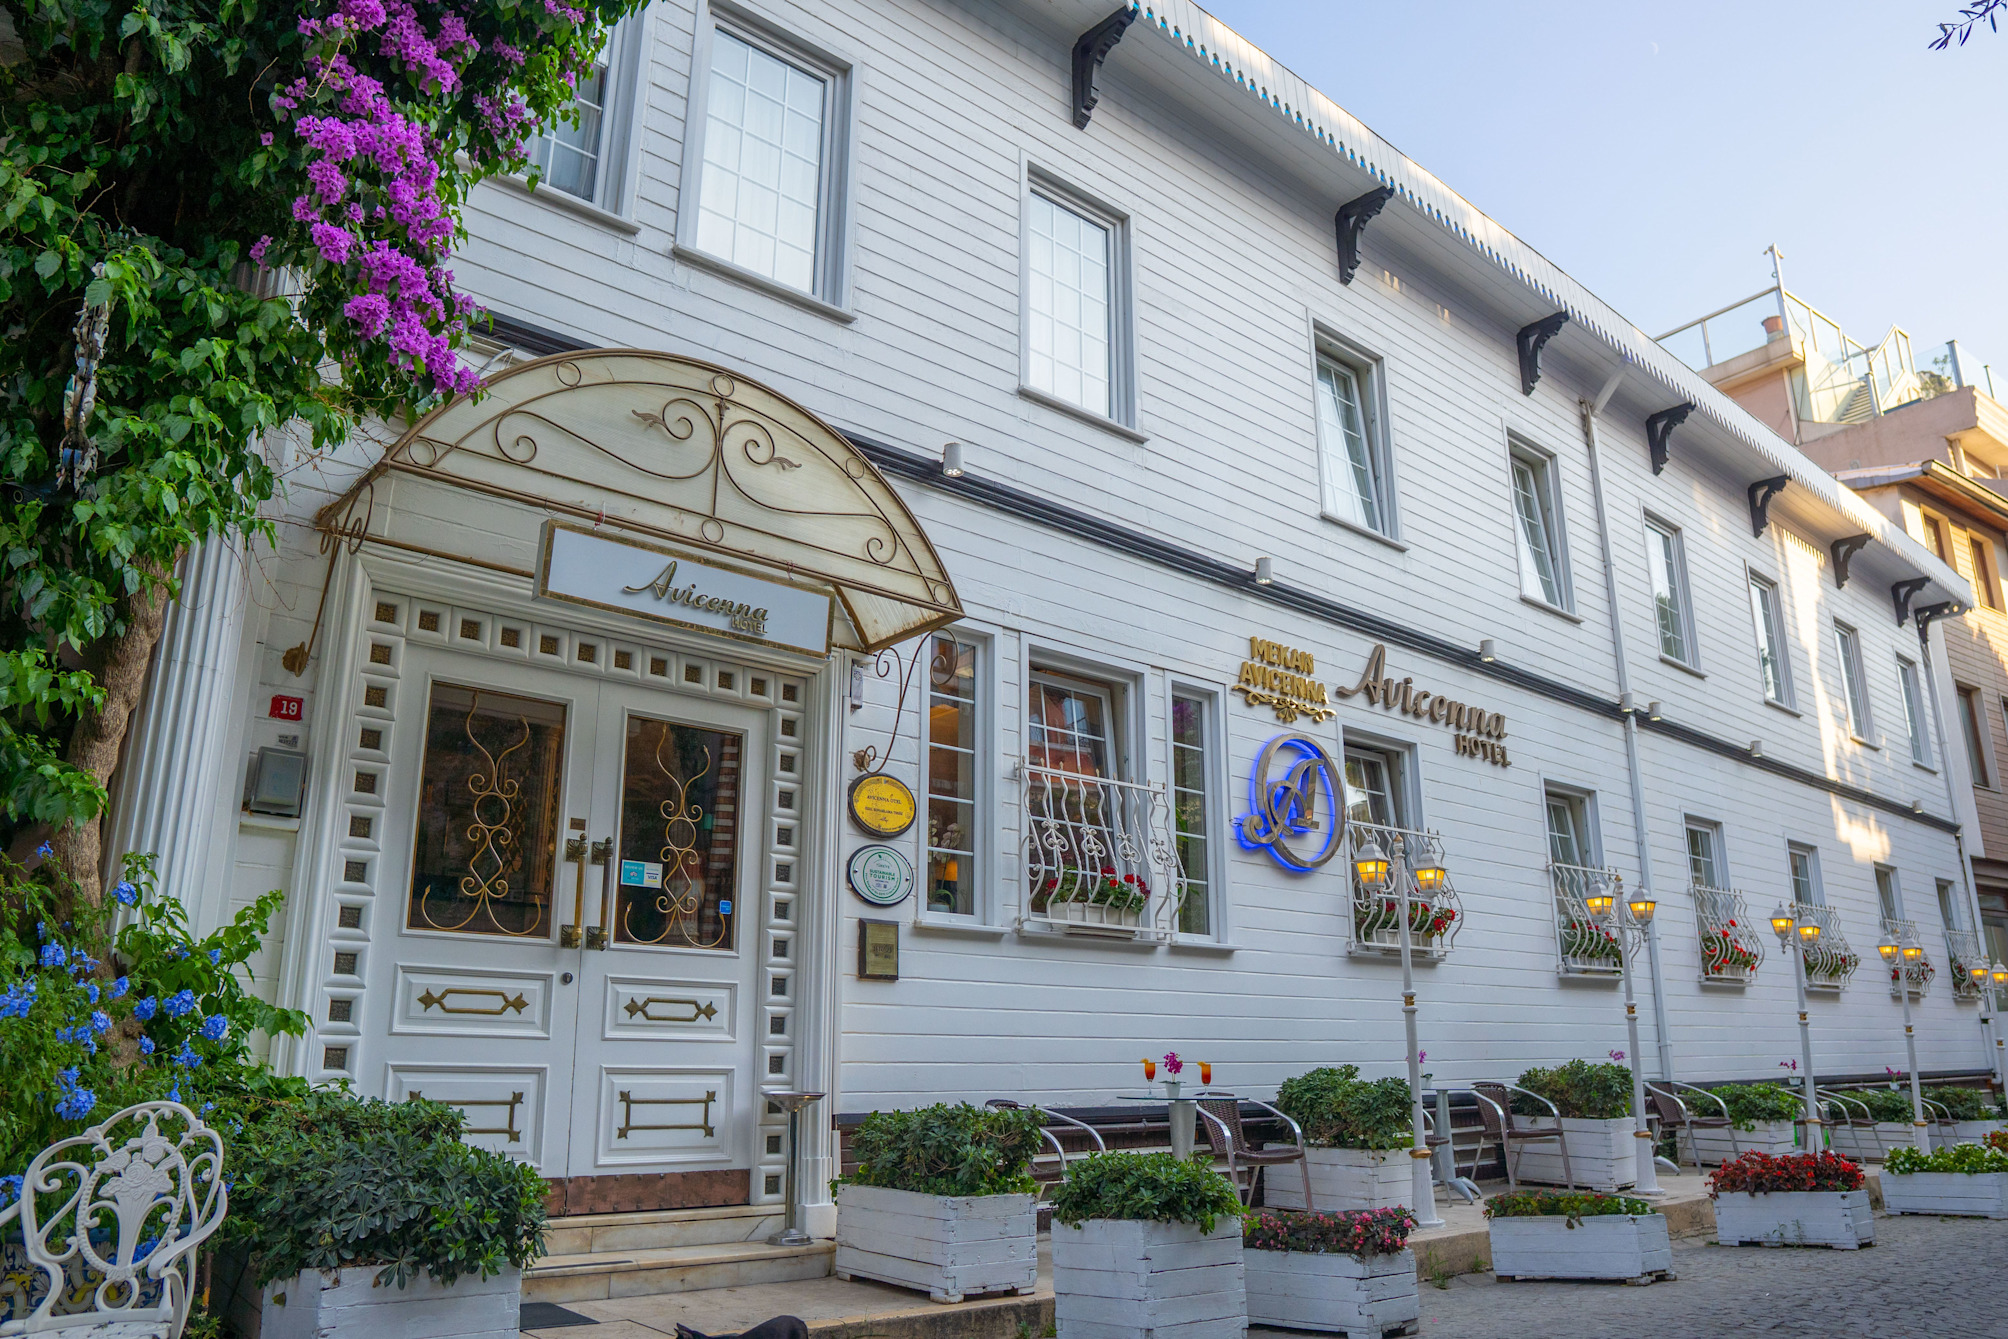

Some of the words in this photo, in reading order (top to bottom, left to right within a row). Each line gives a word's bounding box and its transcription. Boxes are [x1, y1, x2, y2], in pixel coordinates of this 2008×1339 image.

[623, 560, 769, 622] Avicenna
[732, 617, 768, 634] HOTEL
[1250, 636, 1315, 675] MEKAN
[1239, 661, 1330, 705] AVICENNA
[1335, 644, 1509, 739] Avicenna
[280, 701, 298, 715] 19
[1455, 733, 1512, 767] HOTEL
[869, 873, 895, 881] TOURISM
